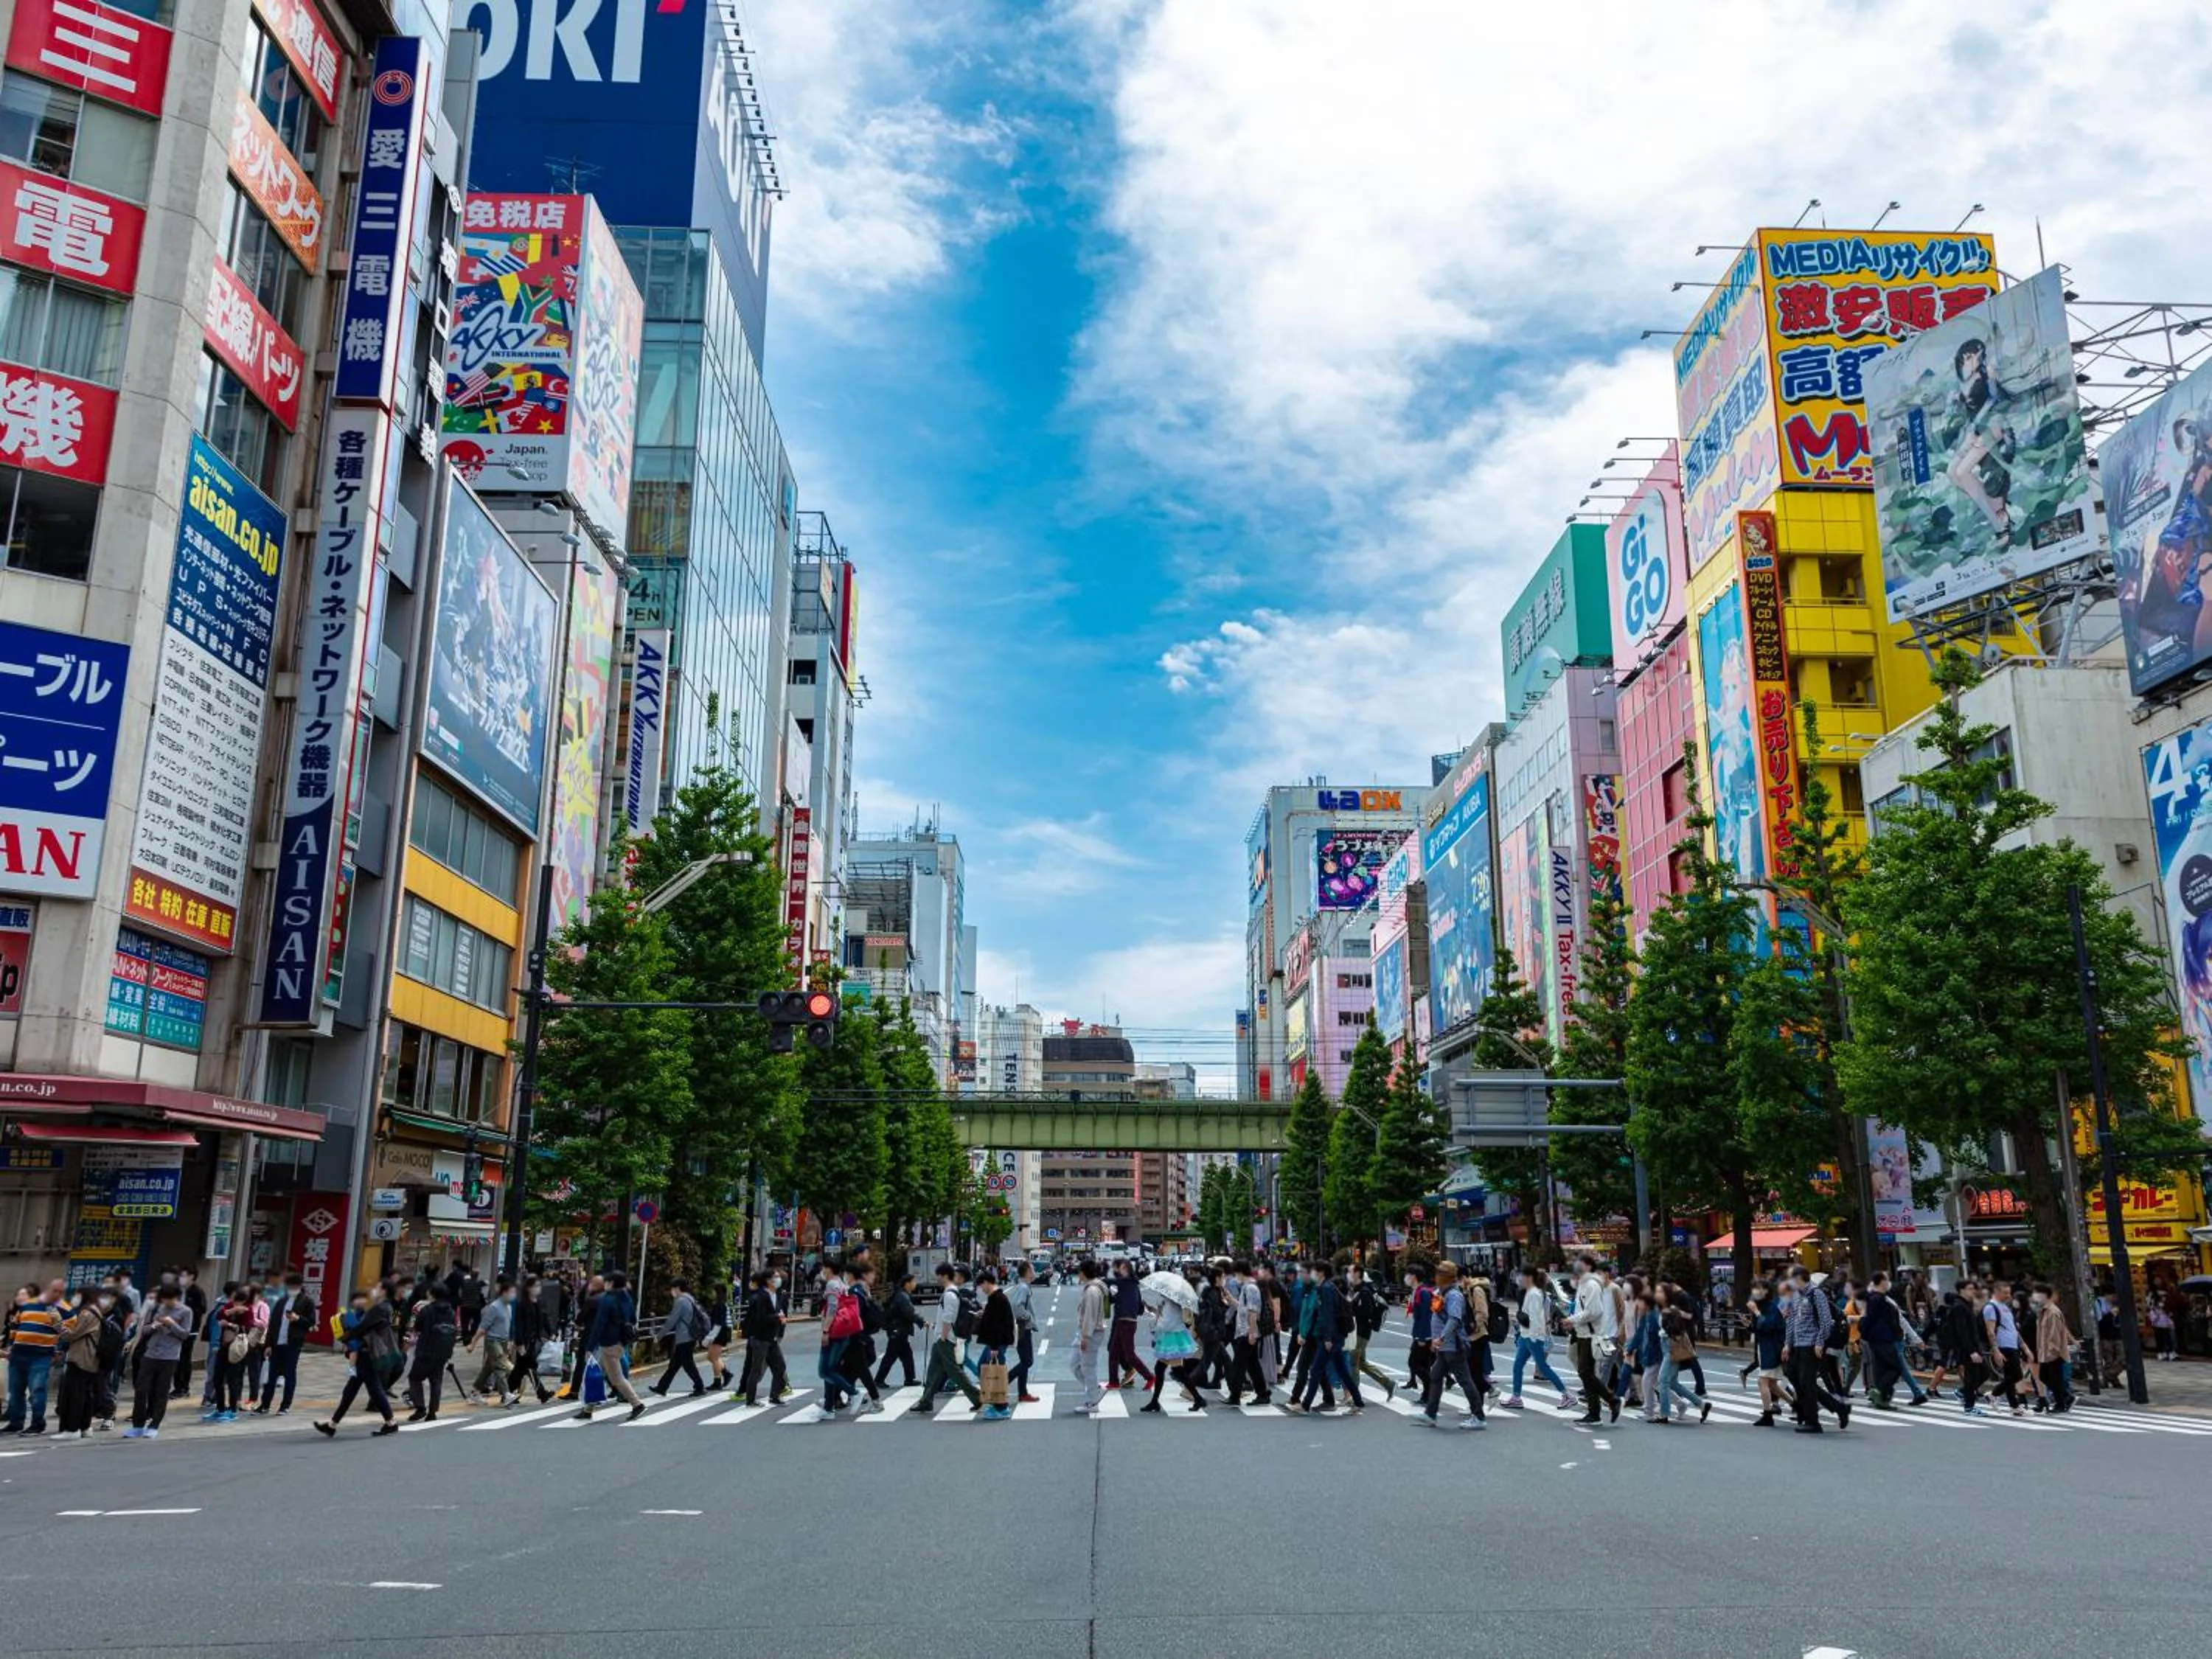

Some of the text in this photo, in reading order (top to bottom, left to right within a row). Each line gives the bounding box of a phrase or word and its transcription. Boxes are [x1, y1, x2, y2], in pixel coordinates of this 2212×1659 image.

[465, 199, 566, 230] 免税店
[345, 128, 406, 361] 愛三電機
[490, 350, 563, 360] INTERNATIONAL
[504, 443, 549, 456] Japan.
[189, 475, 279, 577] aisan.co.jp
[1750, 573, 1773, 583] DVD
[297, 430, 366, 799] 各種ケーブル・ネットワーク機器
[1756, 609, 1773, 619] CD
[636, 639, 662, 732] AKKY
[0, 734, 97, 792] ーツ
[274, 824, 319, 1000] AISAN
